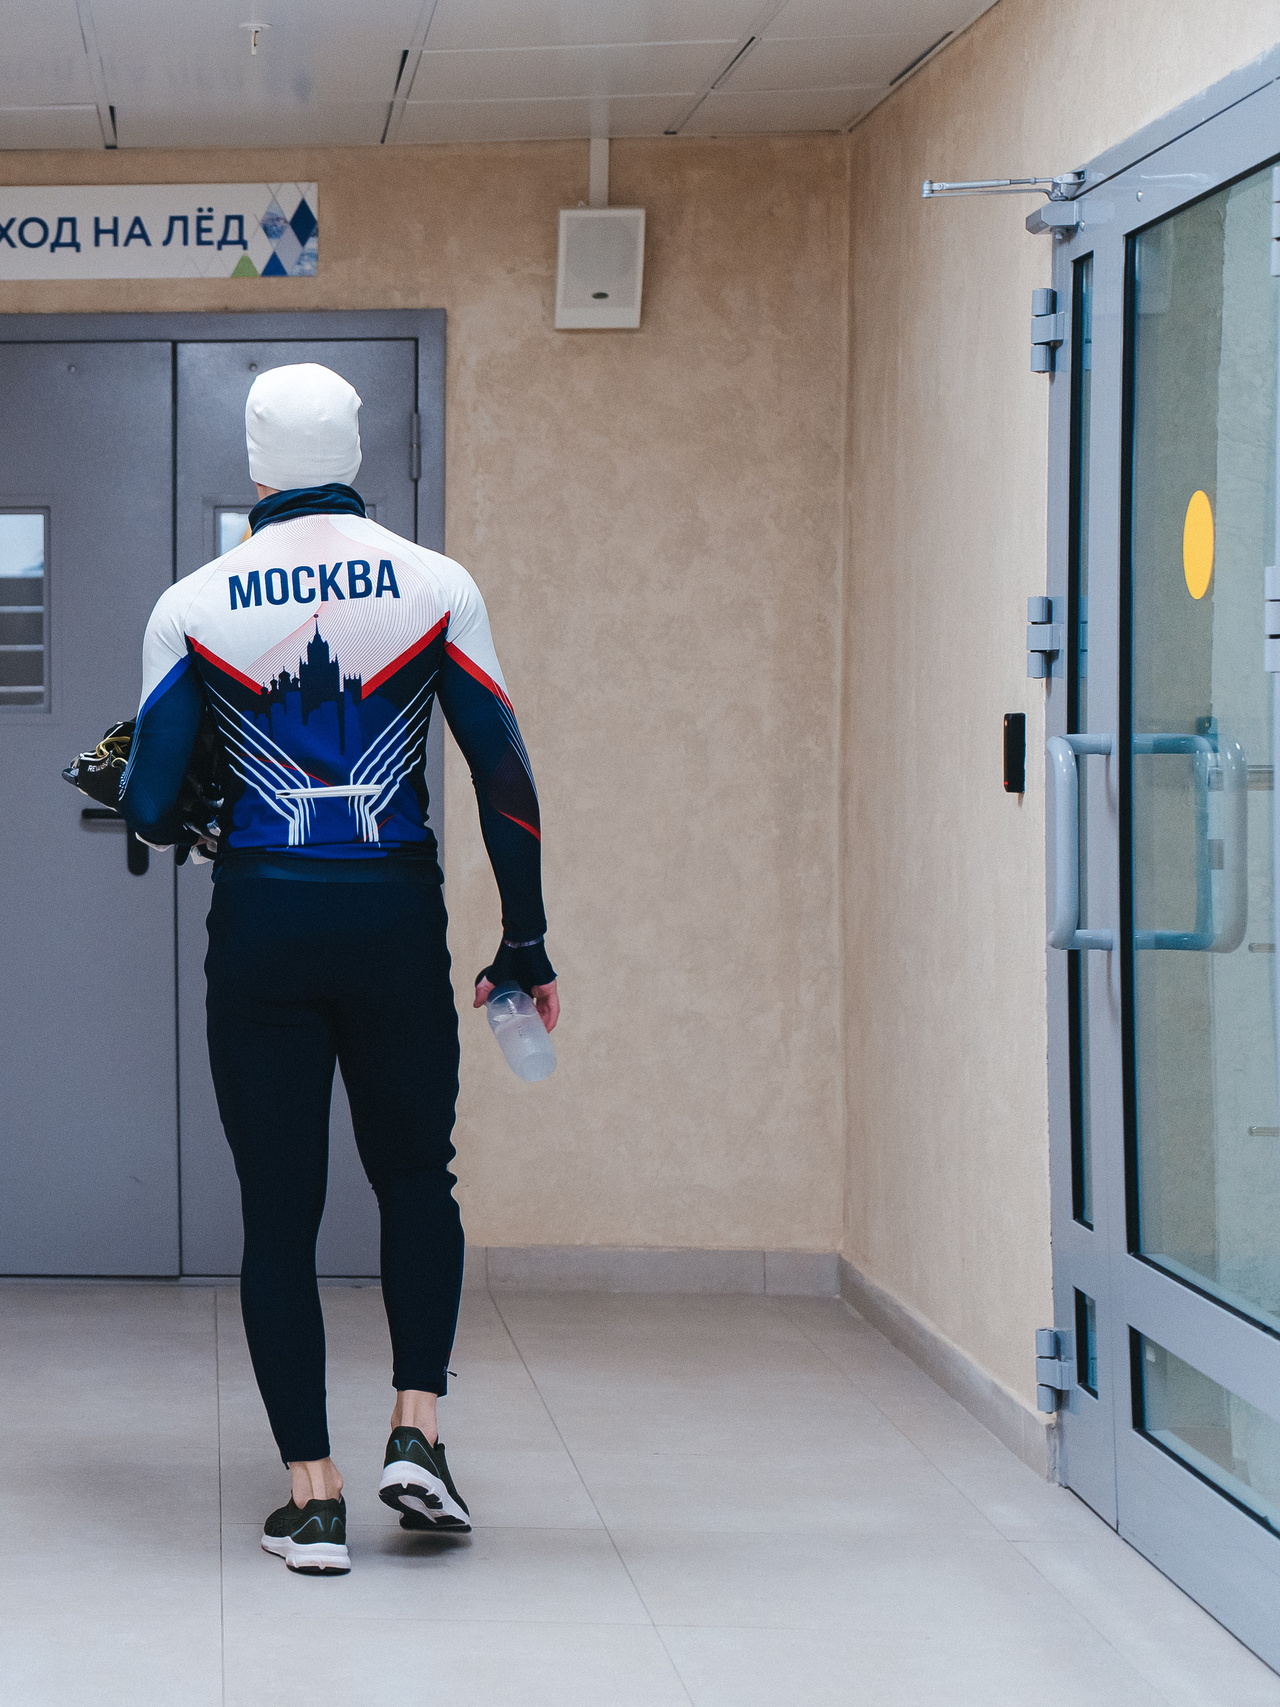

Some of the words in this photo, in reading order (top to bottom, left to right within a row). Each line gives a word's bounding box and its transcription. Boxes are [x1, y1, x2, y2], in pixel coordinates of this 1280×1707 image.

[94, 215, 152, 247] НА
[162, 206, 248, 251] ЛЁД
[228, 559, 401, 611] МОСКВА
